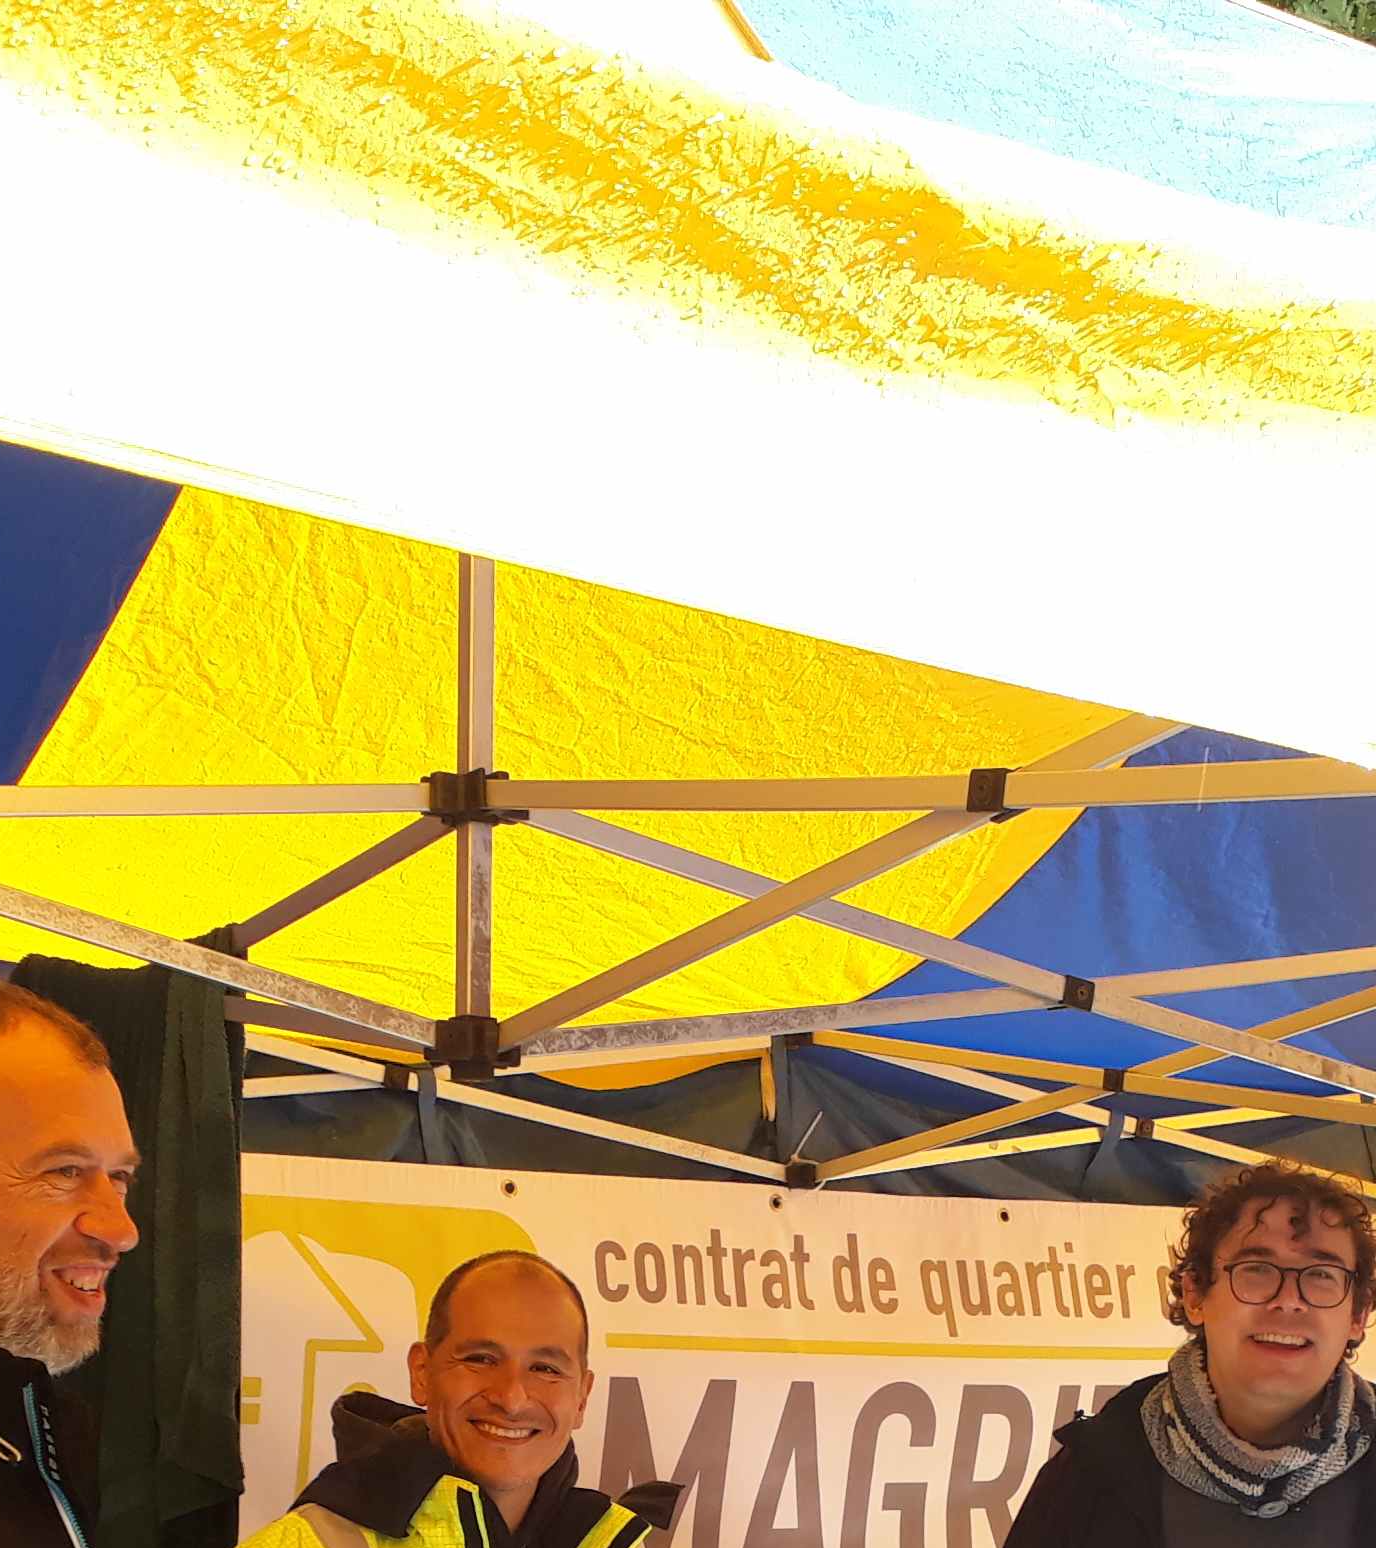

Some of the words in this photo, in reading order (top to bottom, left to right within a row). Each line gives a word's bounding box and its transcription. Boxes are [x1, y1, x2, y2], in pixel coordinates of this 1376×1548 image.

[594, 1228, 817, 1311] contrat
[832, 1233, 900, 1315] de
[920, 1241, 1137, 1337] quartier
